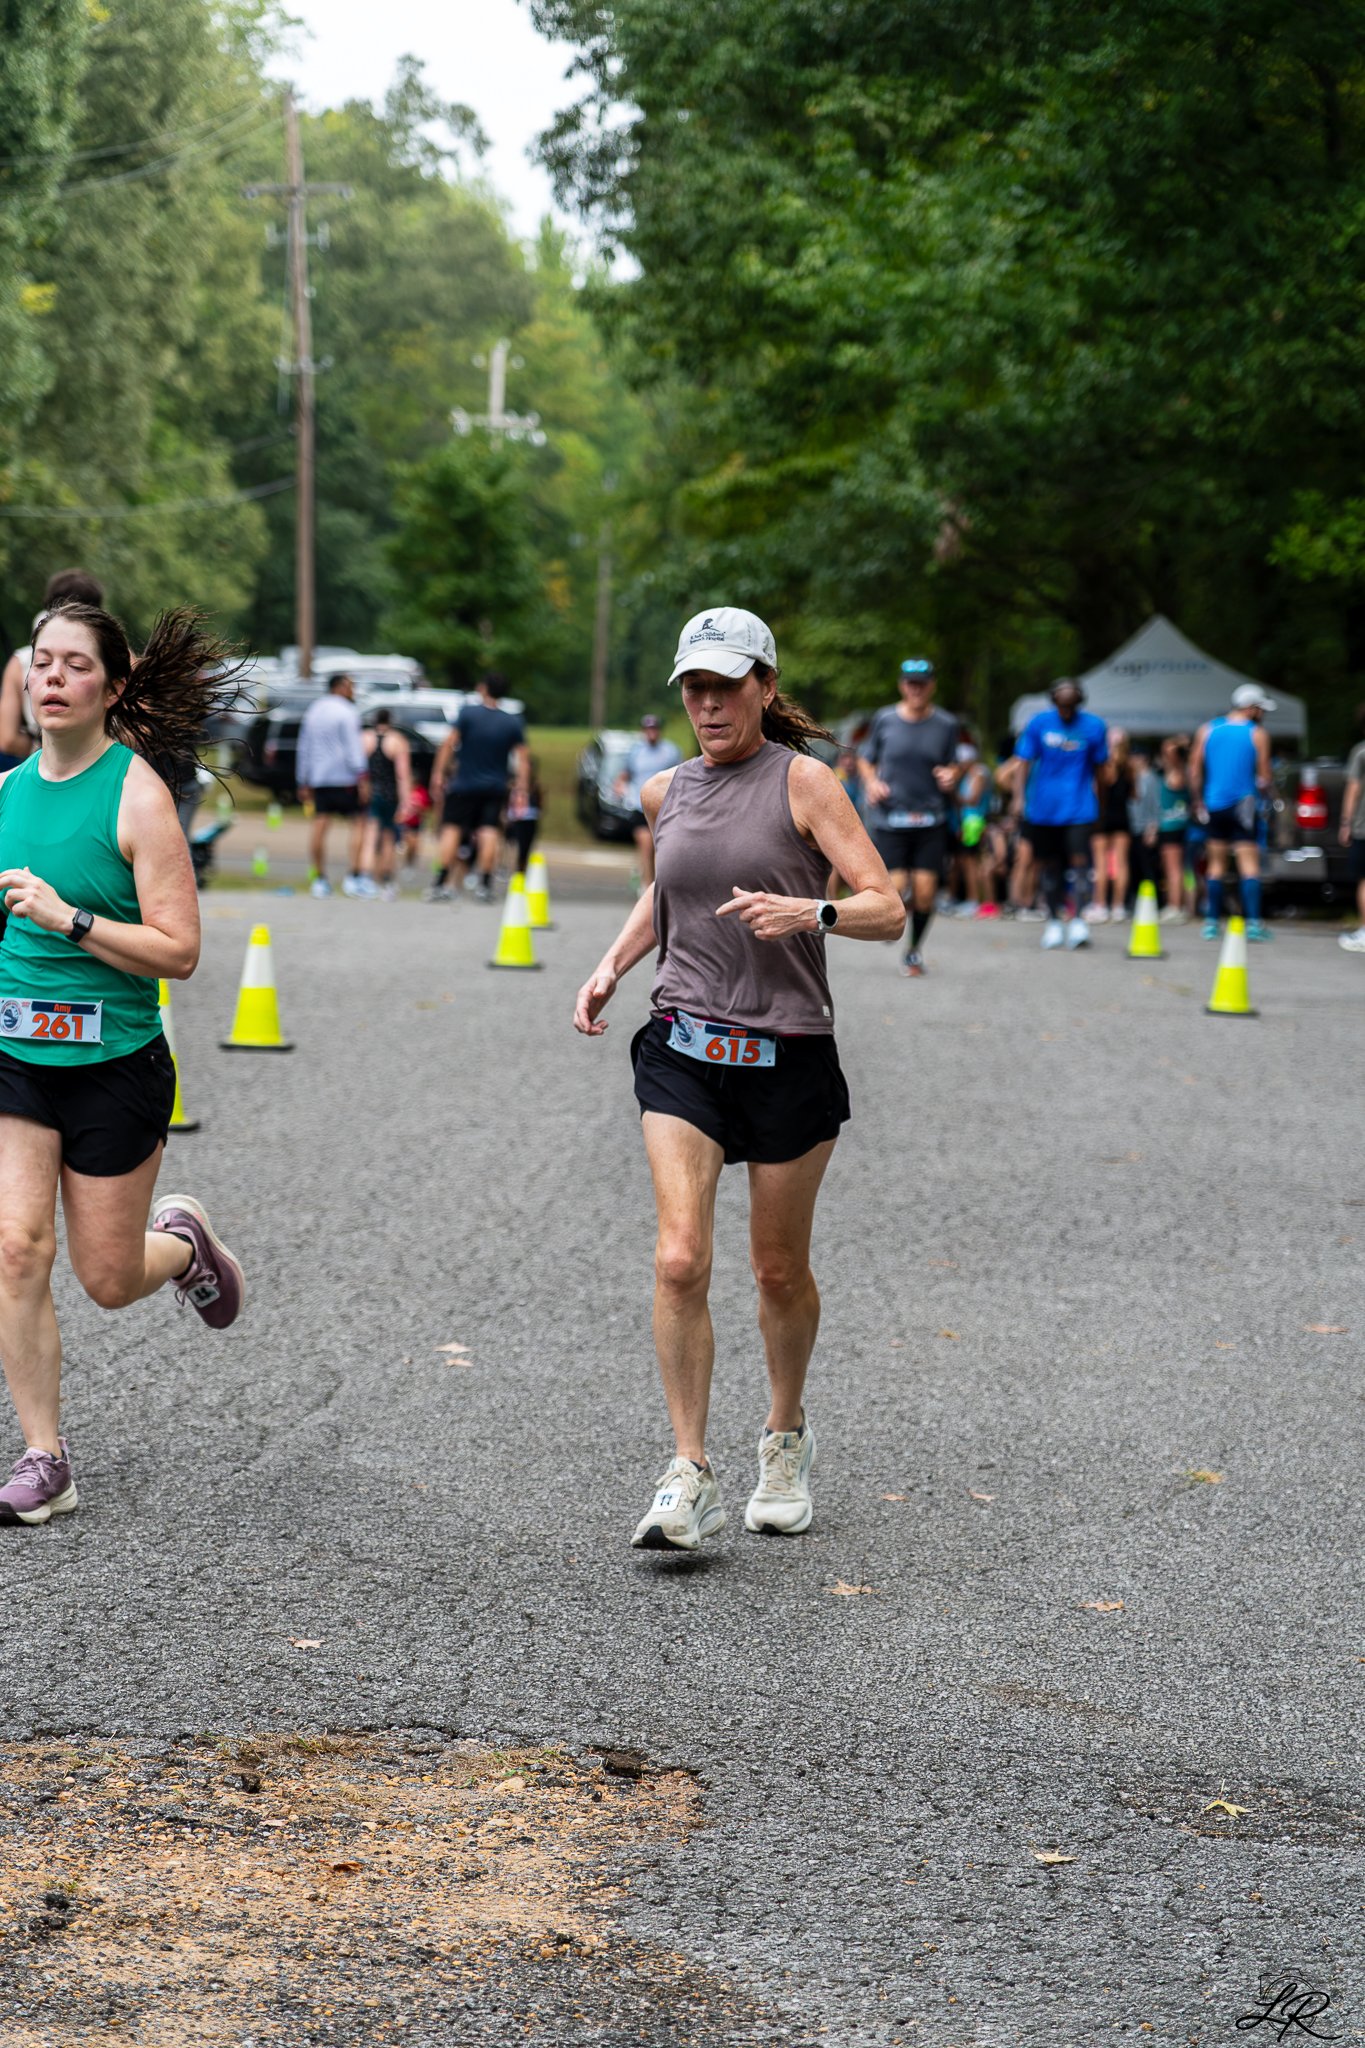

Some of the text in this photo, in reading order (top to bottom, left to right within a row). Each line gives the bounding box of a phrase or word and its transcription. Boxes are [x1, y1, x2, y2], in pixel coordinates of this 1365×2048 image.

[53, 1003, 72, 1014] Amy
[31, 1012, 84, 1040] 261
[729, 1028, 748, 1038] Amy
[705, 1036, 761, 1064] 615
